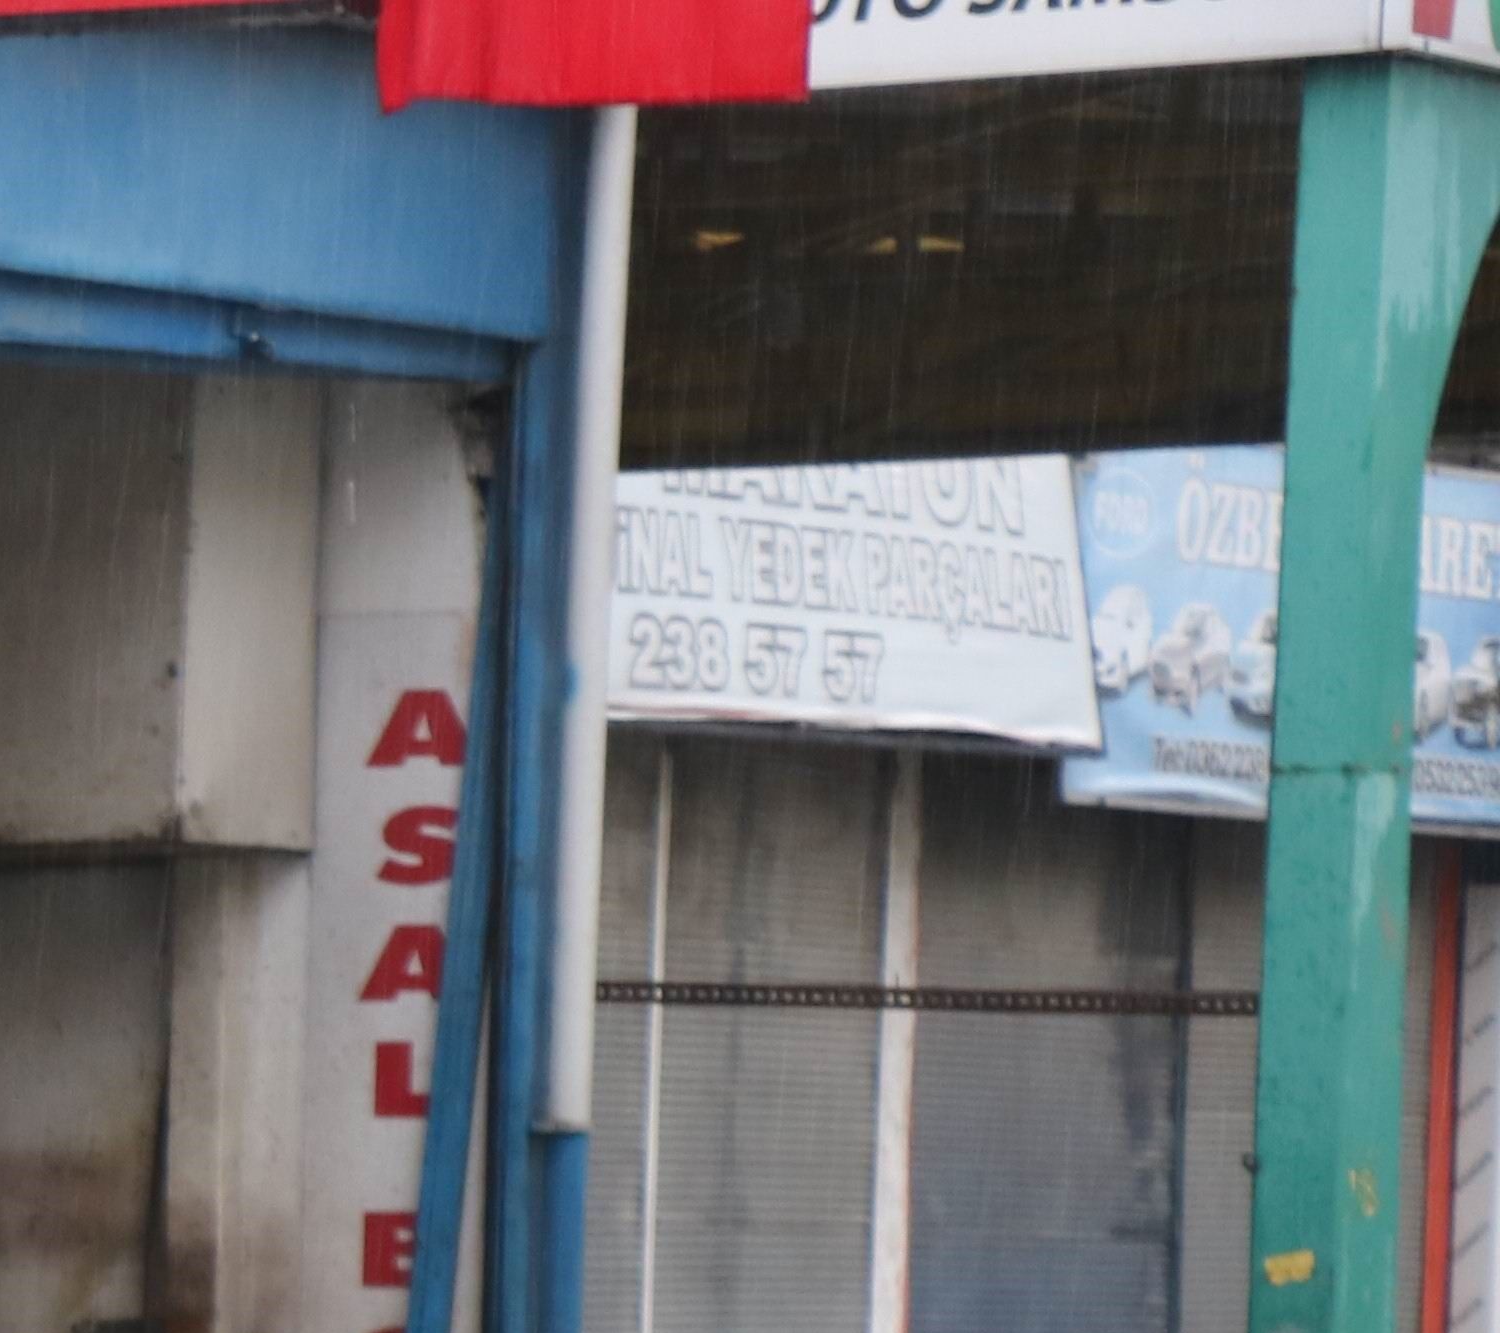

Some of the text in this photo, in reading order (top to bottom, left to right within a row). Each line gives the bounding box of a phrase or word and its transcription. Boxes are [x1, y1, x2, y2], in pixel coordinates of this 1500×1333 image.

[718, 515, 860, 612] YEDEK
[862, 530, 1074, 645] PARÇALARI
[628, 610, 886, 703] 238 57 57
